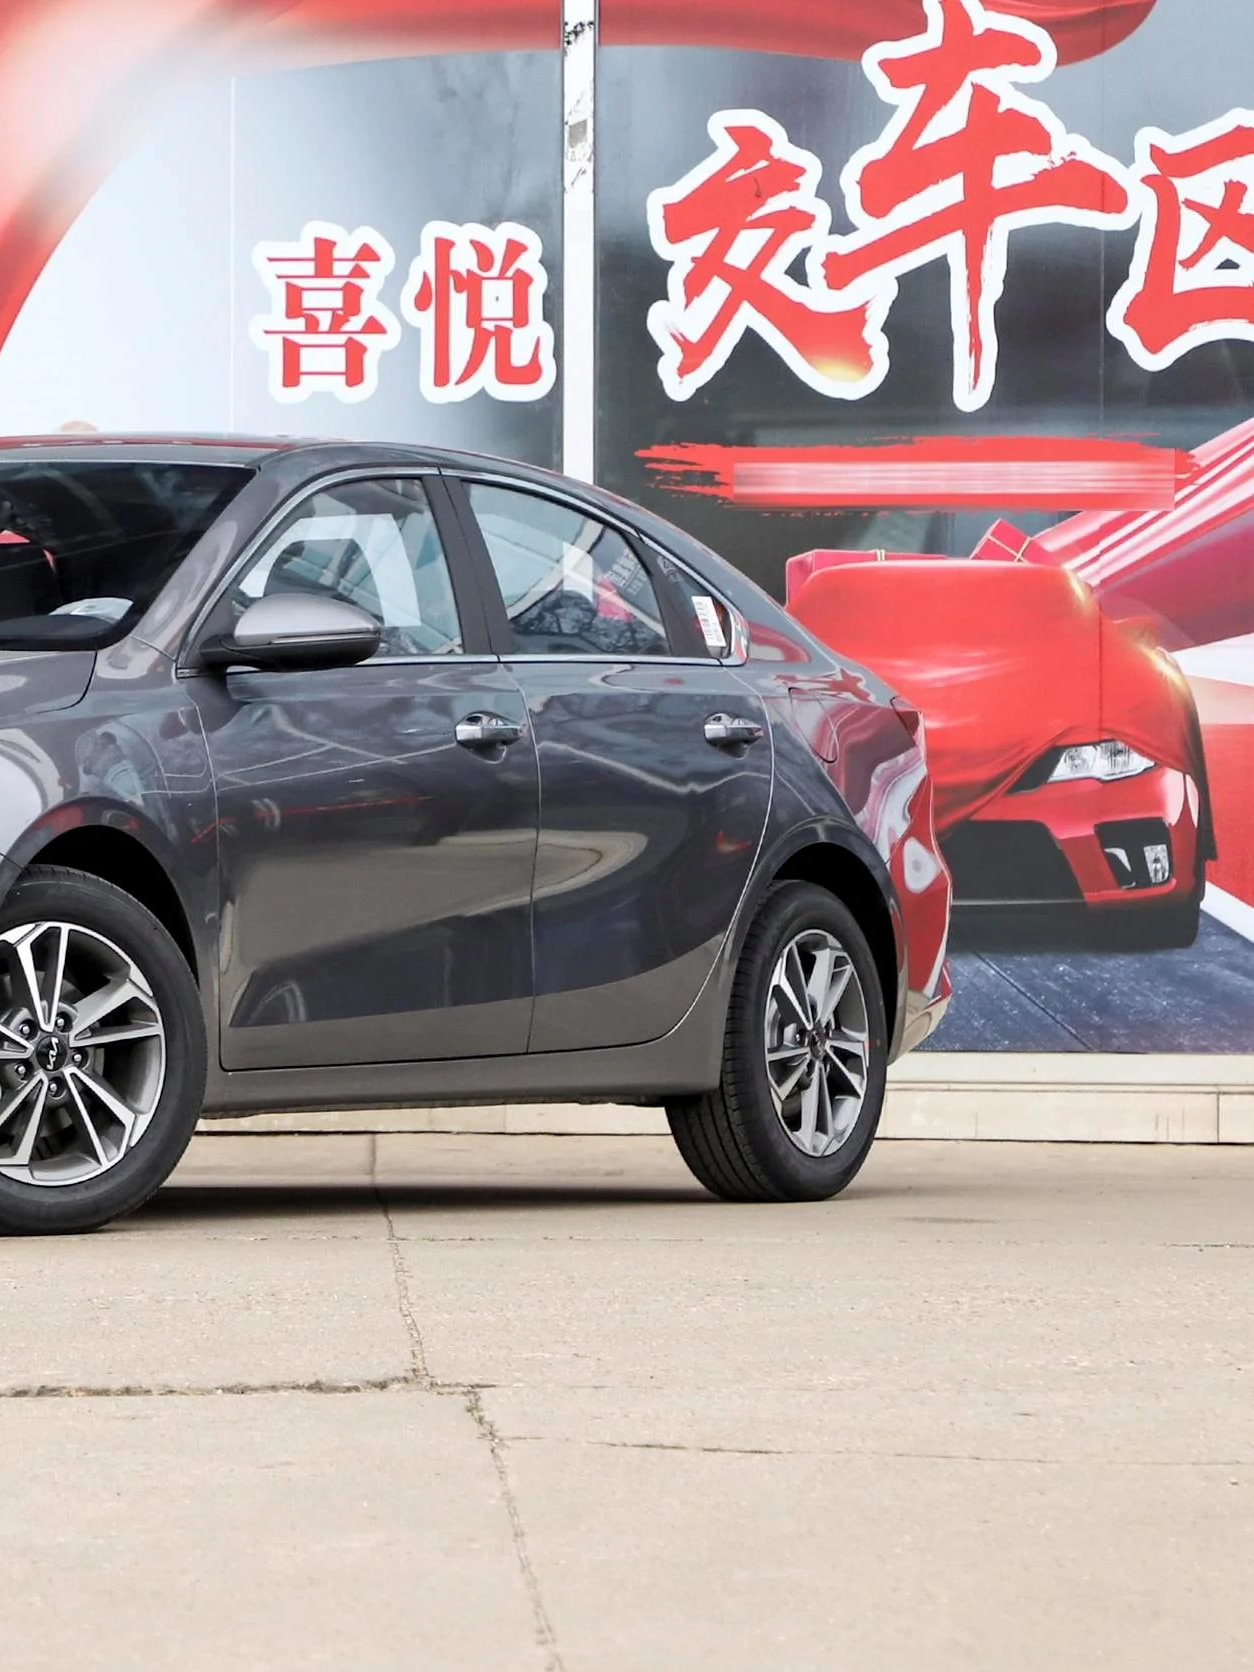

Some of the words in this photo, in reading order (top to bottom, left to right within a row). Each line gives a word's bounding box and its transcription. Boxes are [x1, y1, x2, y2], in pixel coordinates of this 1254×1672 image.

[260, 232, 545, 390] 喜悦
[656, 0, 1254, 400] 交车区
